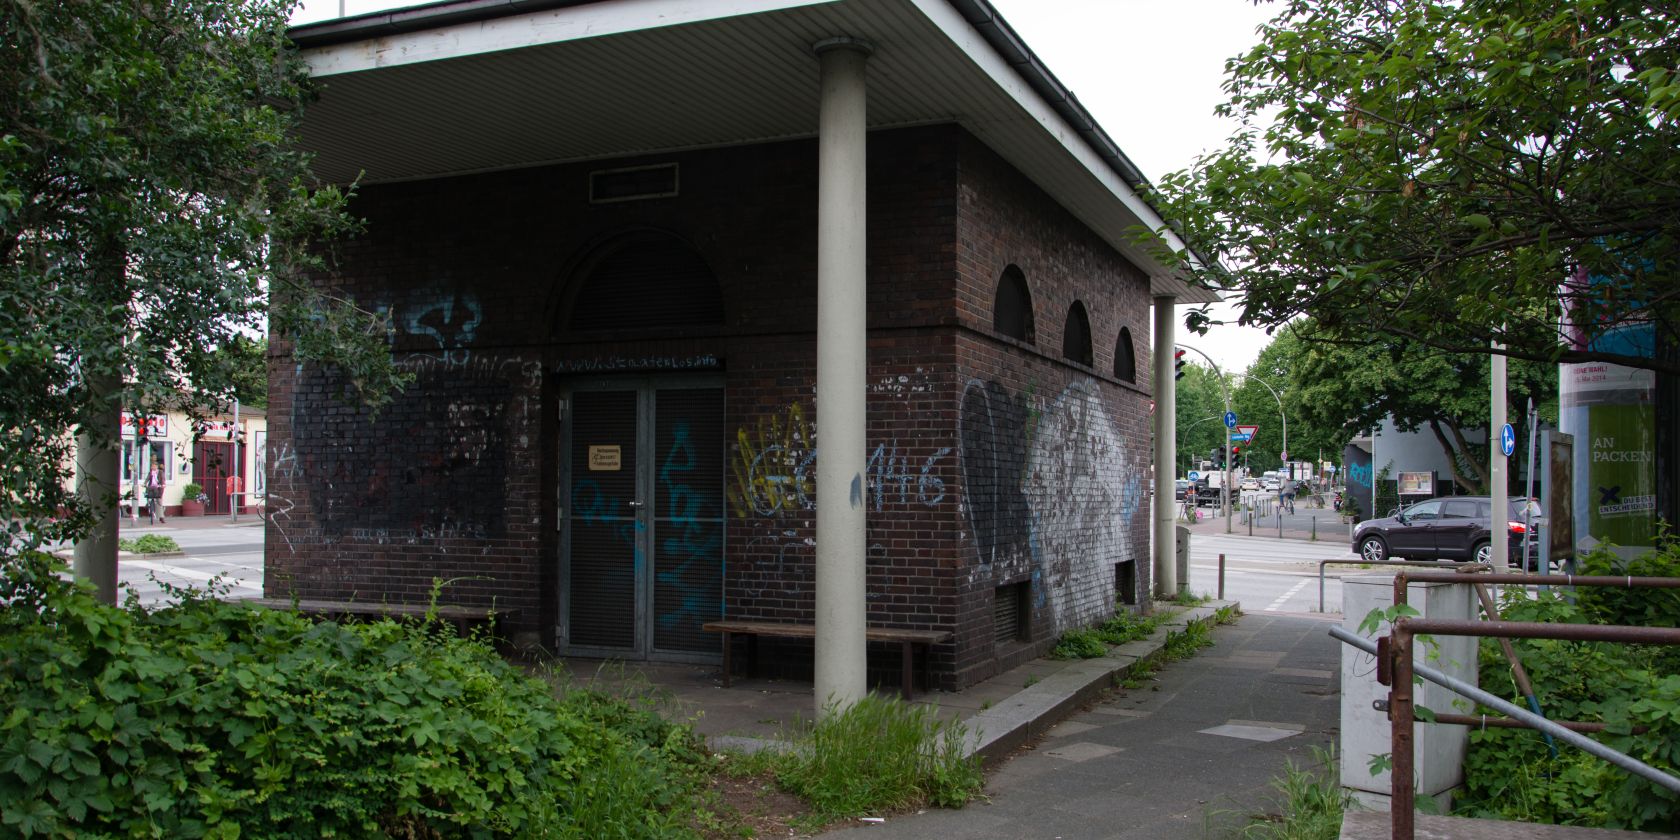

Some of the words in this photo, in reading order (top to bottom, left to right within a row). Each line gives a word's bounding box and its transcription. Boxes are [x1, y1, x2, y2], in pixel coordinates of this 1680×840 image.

[1593, 437, 1615, 449] AN
[1593, 450, 1652, 463] PACKEN
[1623, 496, 1634, 504] DU
